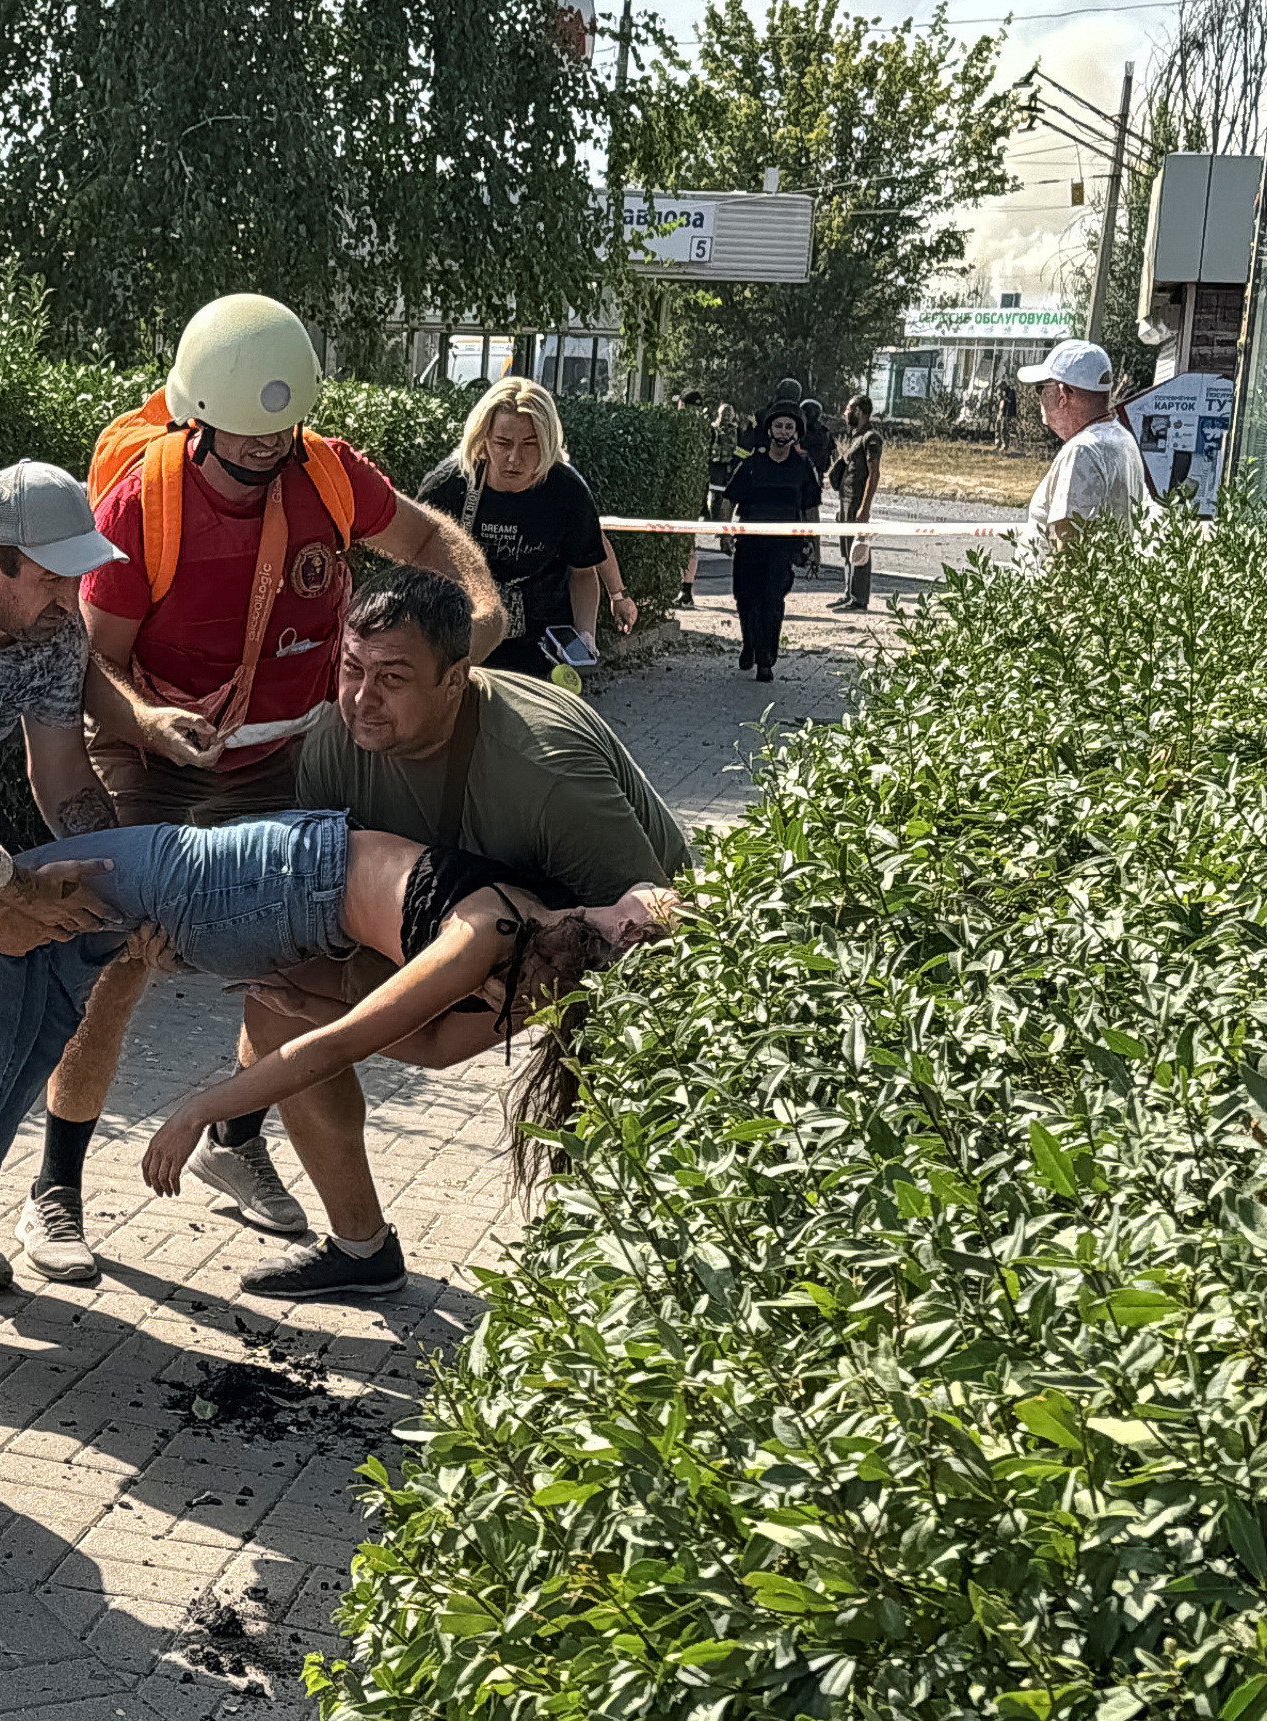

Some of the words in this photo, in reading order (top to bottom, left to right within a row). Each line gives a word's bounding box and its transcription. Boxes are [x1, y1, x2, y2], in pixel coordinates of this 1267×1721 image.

[695, 239, 707, 259] 5
[974, 312, 1079, 326] ОБСЛУГОВУВАН
[1154, 401, 1196, 411] КАРТОК
[481, 522, 518, 534] DREAMS
